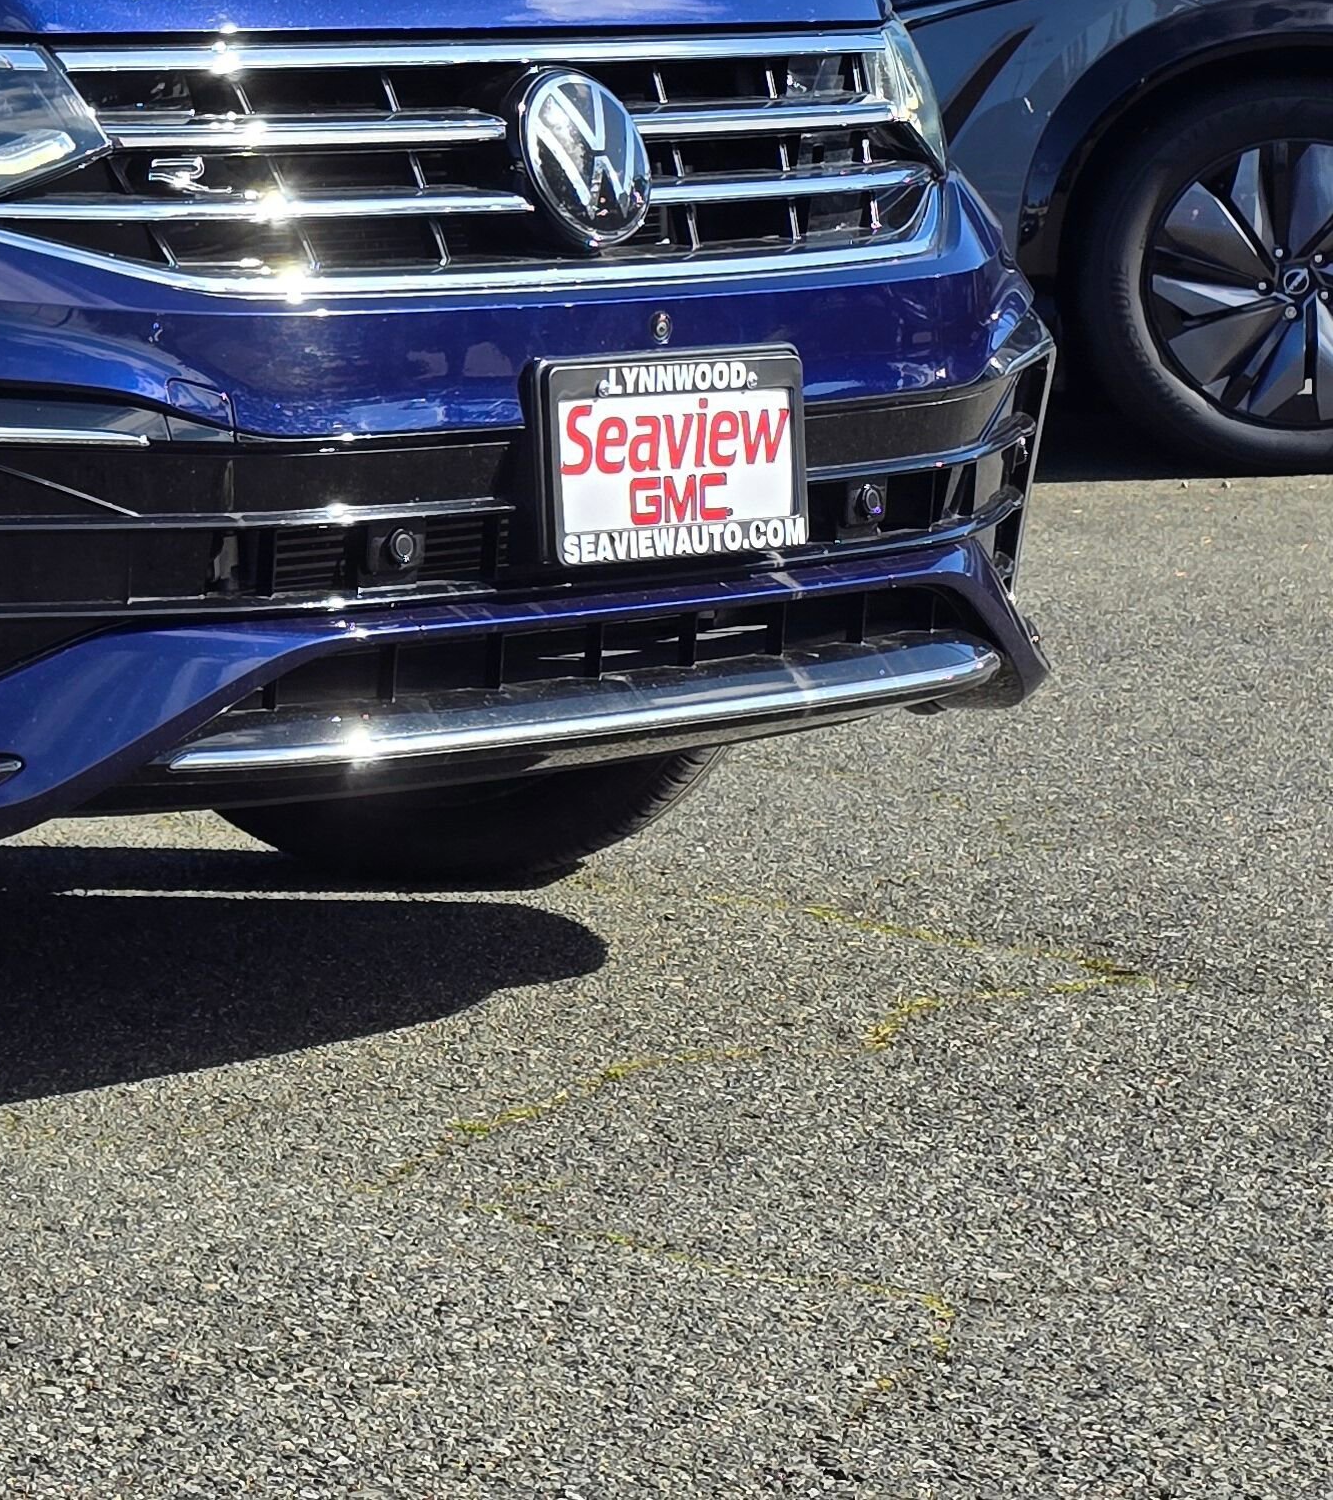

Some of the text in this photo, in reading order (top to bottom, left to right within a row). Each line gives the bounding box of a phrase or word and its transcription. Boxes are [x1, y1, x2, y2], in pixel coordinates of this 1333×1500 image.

[607, 361, 748, 396] LYNNWOOD
[560, 398, 790, 476] Seaview
[630, 472, 733, 526] GMC
[563, 517, 807, 564] SEAVIEWAUTO.COM
